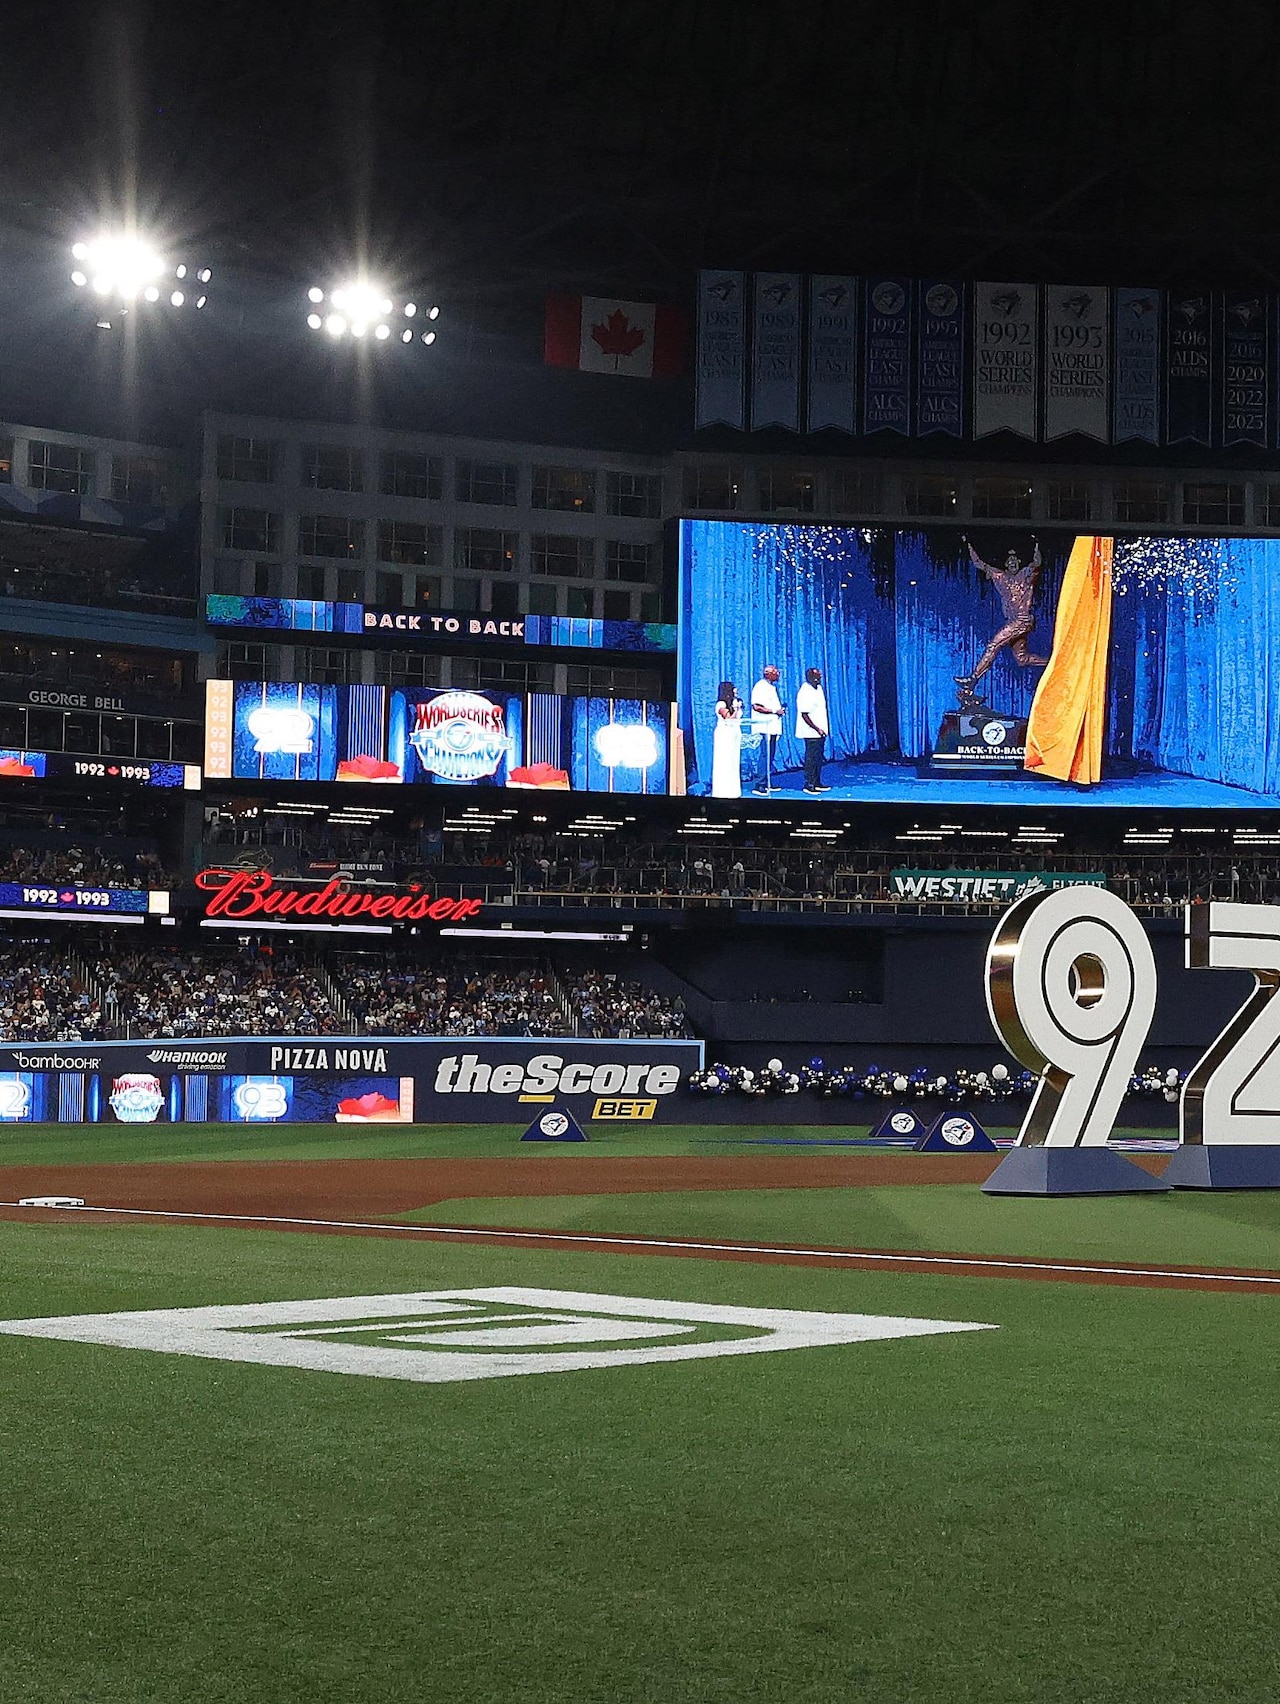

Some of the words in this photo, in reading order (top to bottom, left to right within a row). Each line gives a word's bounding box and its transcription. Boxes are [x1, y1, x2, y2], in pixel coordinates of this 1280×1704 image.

[706, 312, 739, 326] 1985
[872, 318, 906, 333] 1992
[926, 320, 958, 336] 1993
[981, 322, 1031, 346] 1992
[1123, 328, 1154, 344] 2015
[1052, 325, 1102, 348] 1993
[1173, 330, 1206, 346] 2016
[980, 350, 1032, 367] WORLD
[1172, 350, 1208, 366] ALDS
[1230, 343, 1262, 358] 2016
[870, 360, 904, 375] EAST
[924, 362, 957, 376] EAST
[1051, 353, 1104, 370] WORLD
[979, 367, 1032, 383] SERIES
[1050, 370, 1104, 386] SERIES
[1170, 366, 1208, 377] CHAMPS
[1228, 366, 1264, 382] 2020
[870, 394, 906, 410] ALCS
[922, 397, 958, 412] ALCS
[1228, 389, 1264, 406] 2022
[1228, 414, 1264, 430] 2025
[365, 613, 420, 629] BACK
[431, 616, 460, 632] TO
[469, 619, 524, 636] BACK
[29, 690, 88, 707] GEORGE
[95, 696, 126, 711] BELL
[211, 696, 228, 708] 92
[210, 726, 227, 738] 92
[210, 741, 226, 753] 93
[210, 756, 226, 768] 92
[75, 762, 105, 776] 1992
[120, 765, 150, 780] 1993
[23, 888, 58, 904] 1992
[76, 891, 110, 906] 1993
[195, 870, 482, 920] Budweiser
[270, 1047, 326, 1070] PIZZA
[334, 1049, 387, 1072] NOVA
[177, 1064, 200, 1072] driving
[434, 1054, 680, 1096] theScore
[0, 1080, 28, 1118] 2
[237, 1084, 288, 1118] 93
[600, 1102, 646, 1116] BET
